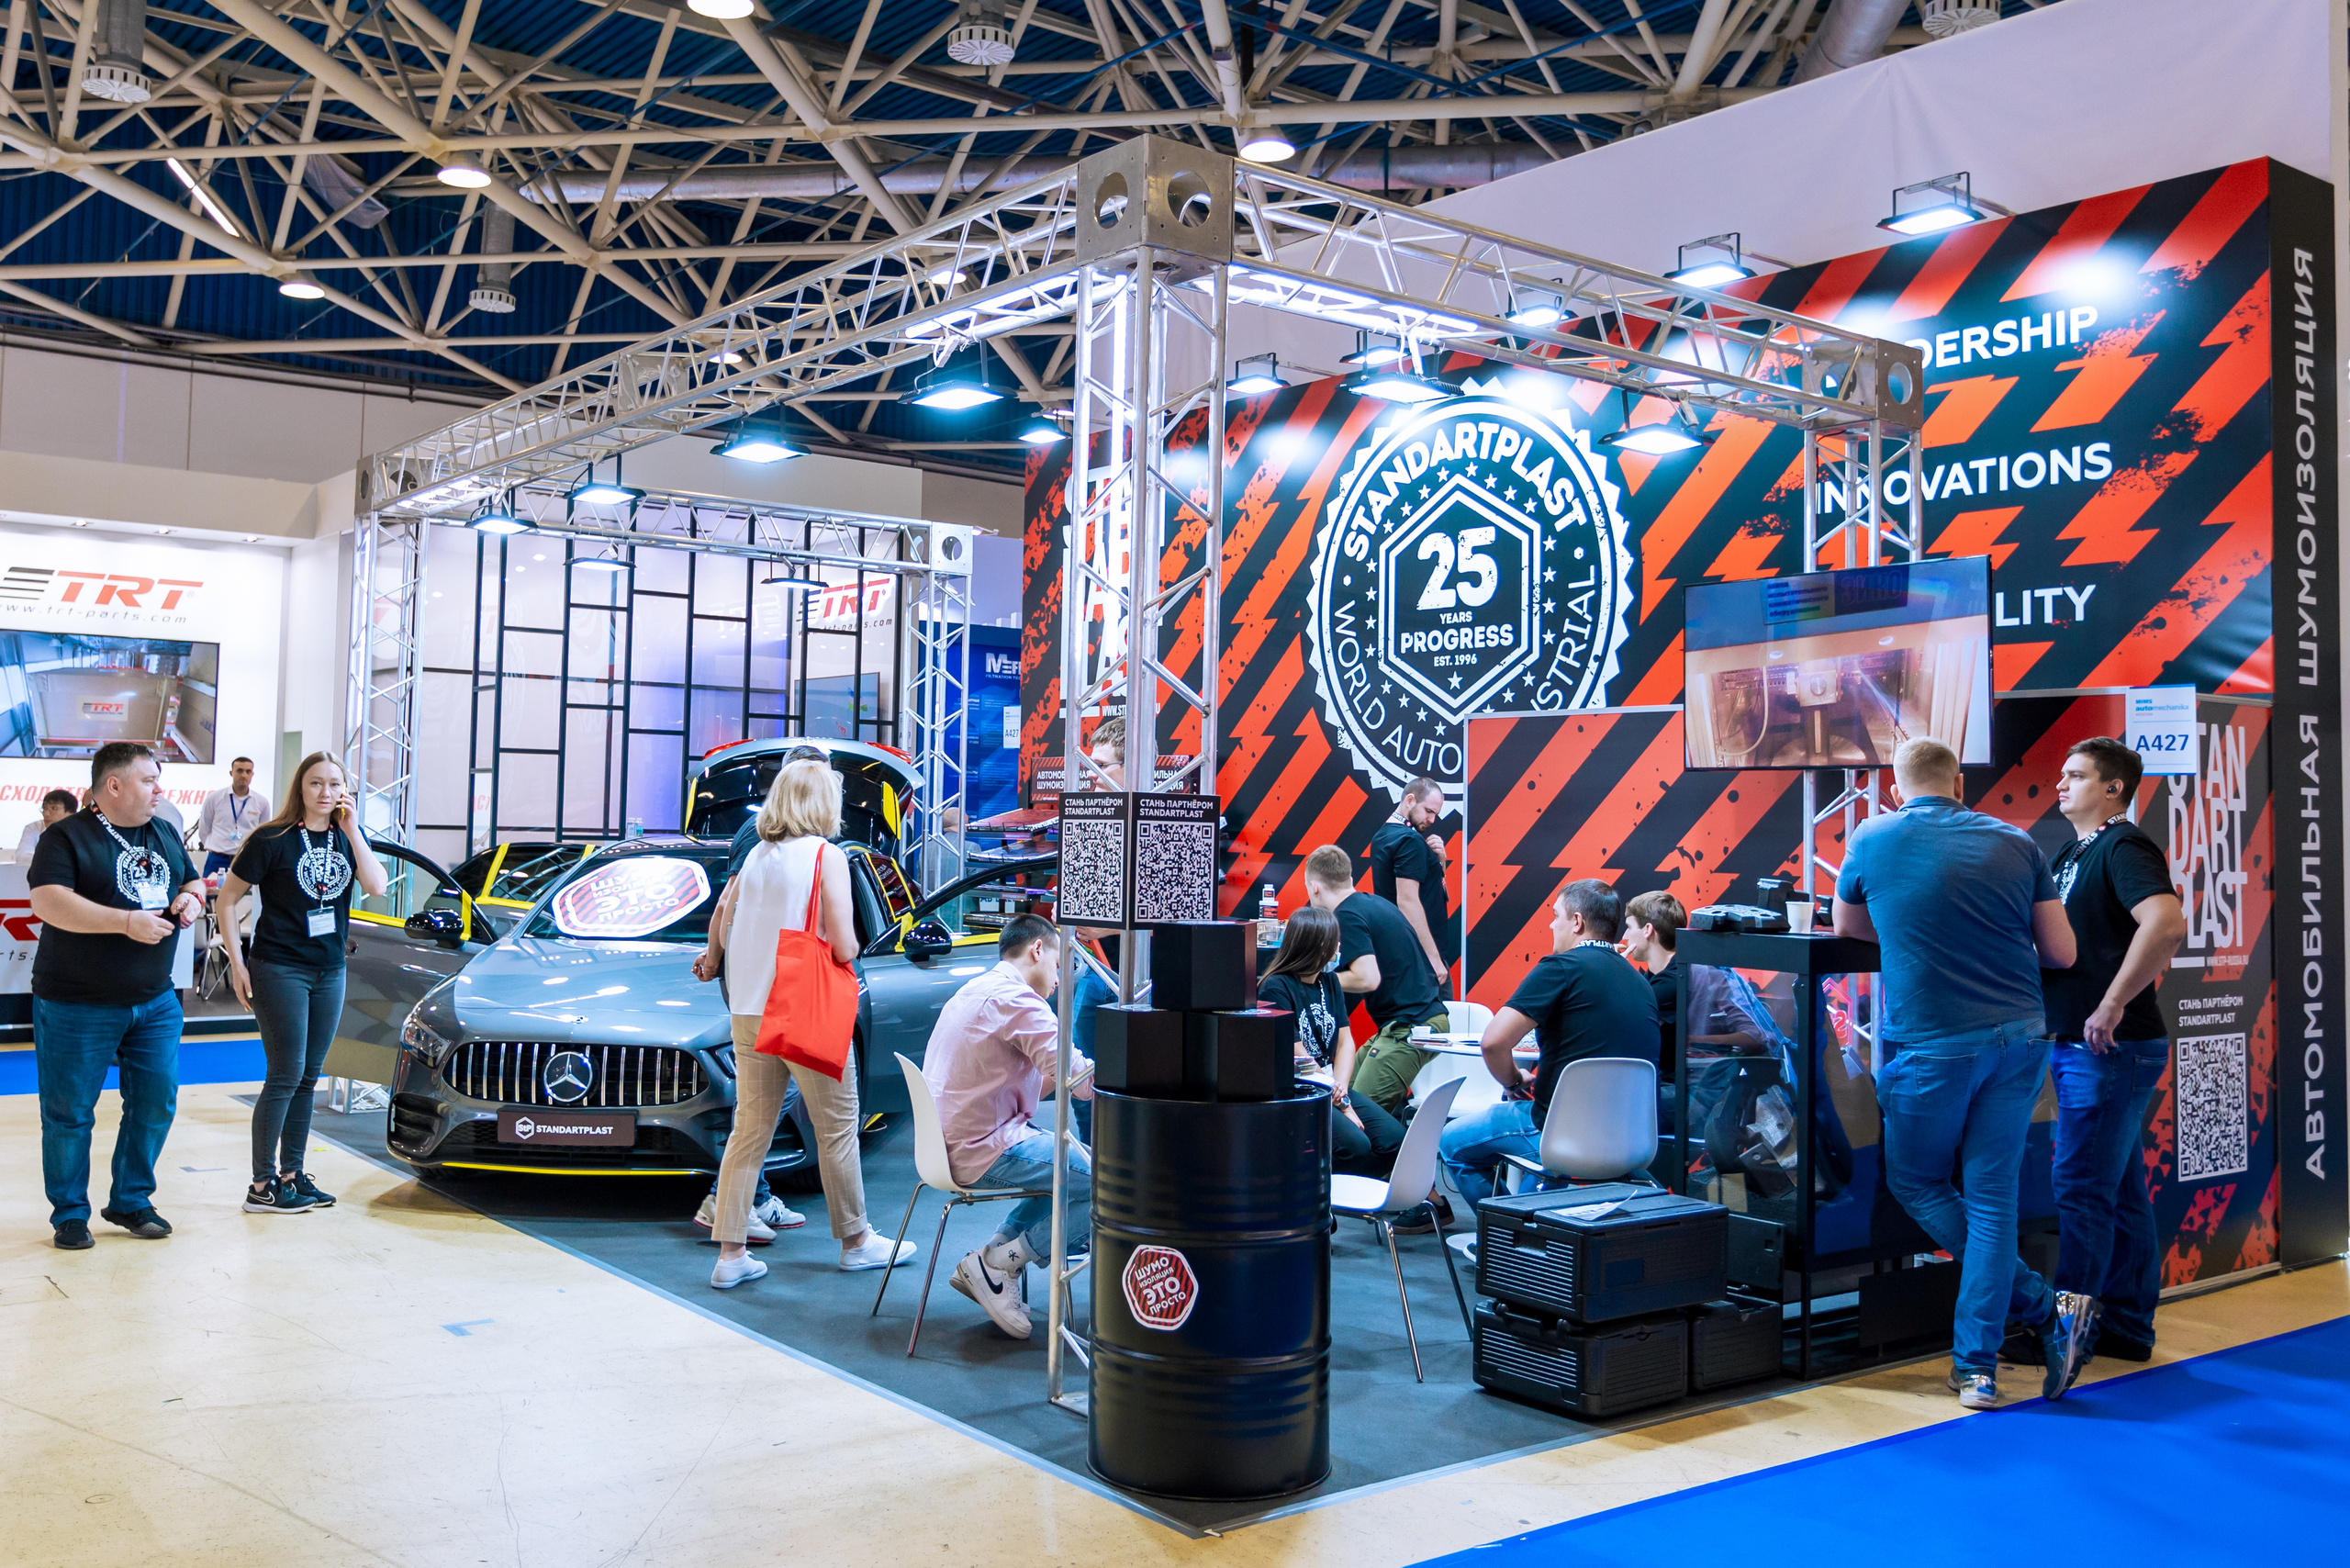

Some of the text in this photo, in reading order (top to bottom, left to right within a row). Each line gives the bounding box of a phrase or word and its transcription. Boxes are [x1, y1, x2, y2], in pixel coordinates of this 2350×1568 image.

[1905, 306, 2098, 369] DERSHIP
[1344, 421, 1587, 562] STANDARTPLAST
[1416, 526, 1498, 610] 25
[57, 570, 204, 610] TRT
[823, 578, 890, 618] TRT
[0, 604, 186, 624] ww.trt-parts.com
[1439, 610, 1472, 624] YEARS
[1995, 585, 2097, 628] LITY
[1400, 624, 1514, 654] PROGRESS
[1530, 565, 1595, 711] STRIAL
[1334, 599, 1385, 730] WORLD
[1433, 655, 1477, 666] EST. 1996
[2294, 248, 2325, 1181] АВТОМОБИЛЬНАЯ ШУМОИЗОЛЯЦИЯ
[1004, 729, 1019, 738] A427
[2135, 734, 2189, 752] A427
[1382, 724, 1462, 775] AUTO
[1065, 799, 1085, 807] СТАНЬ
[1085, 797, 1123, 807] ПАРТНЁРОМ
[1139, 809, 1203, 818] STANDARTPLAST
[1140, 798, 1214, 810] СТАНЬ ПАРТНЁРОМ
[2168, 795, 2247, 873] DART
[595, 883, 676, 913] ЭТО
[598, 898, 680, 923] ПРОСТО
[2178, 994, 2244, 1011] СТАНЬ ПАРТНЁРОМ
[2178, 1013, 2235, 1027] STANDARTPLAST
[518, 1124, 613, 1135] StP STANDARTPLAST
[1135, 1257, 1169, 1280] ШУМО
[1138, 1267, 1174, 1288] ИЗОЛЯЦИЯ
[1143, 1276, 1181, 1305] ЭТО
[1149, 1292, 1186, 1315] ПРОСТО
